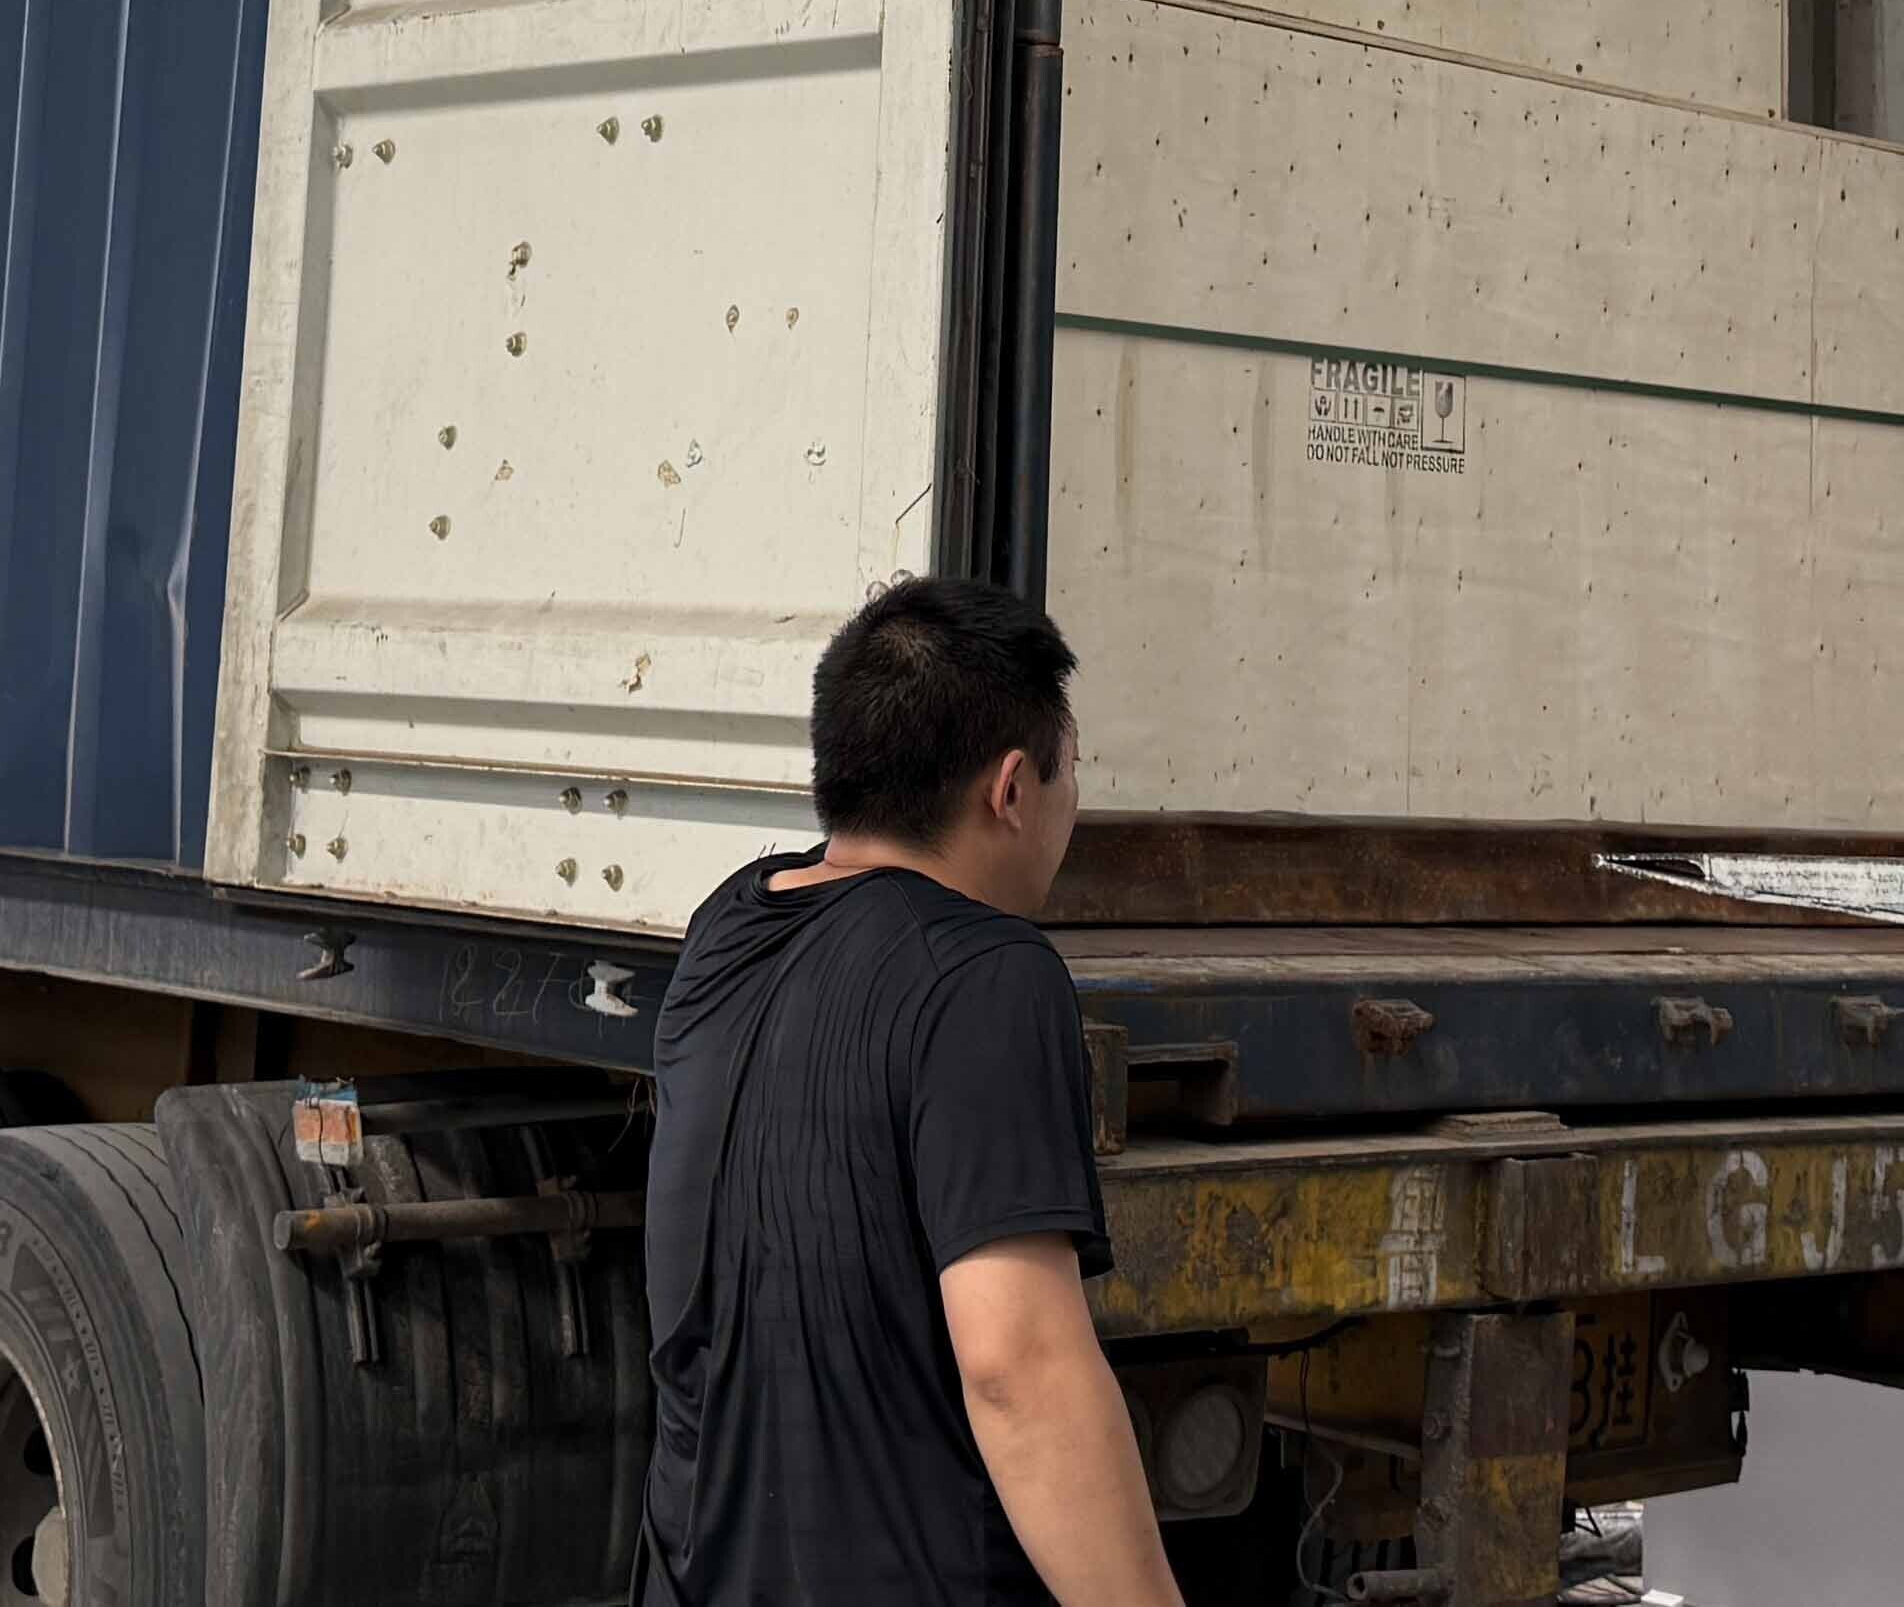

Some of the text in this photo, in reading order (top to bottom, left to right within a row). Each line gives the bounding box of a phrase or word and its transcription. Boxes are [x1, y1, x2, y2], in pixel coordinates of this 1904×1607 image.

[1311, 359, 1421, 397] FRAGILE
[1308, 426, 1419, 451] HANDLE WITH CARE
[1307, 444, 1465, 474] DO NOT FALL NOT PRESSURE
